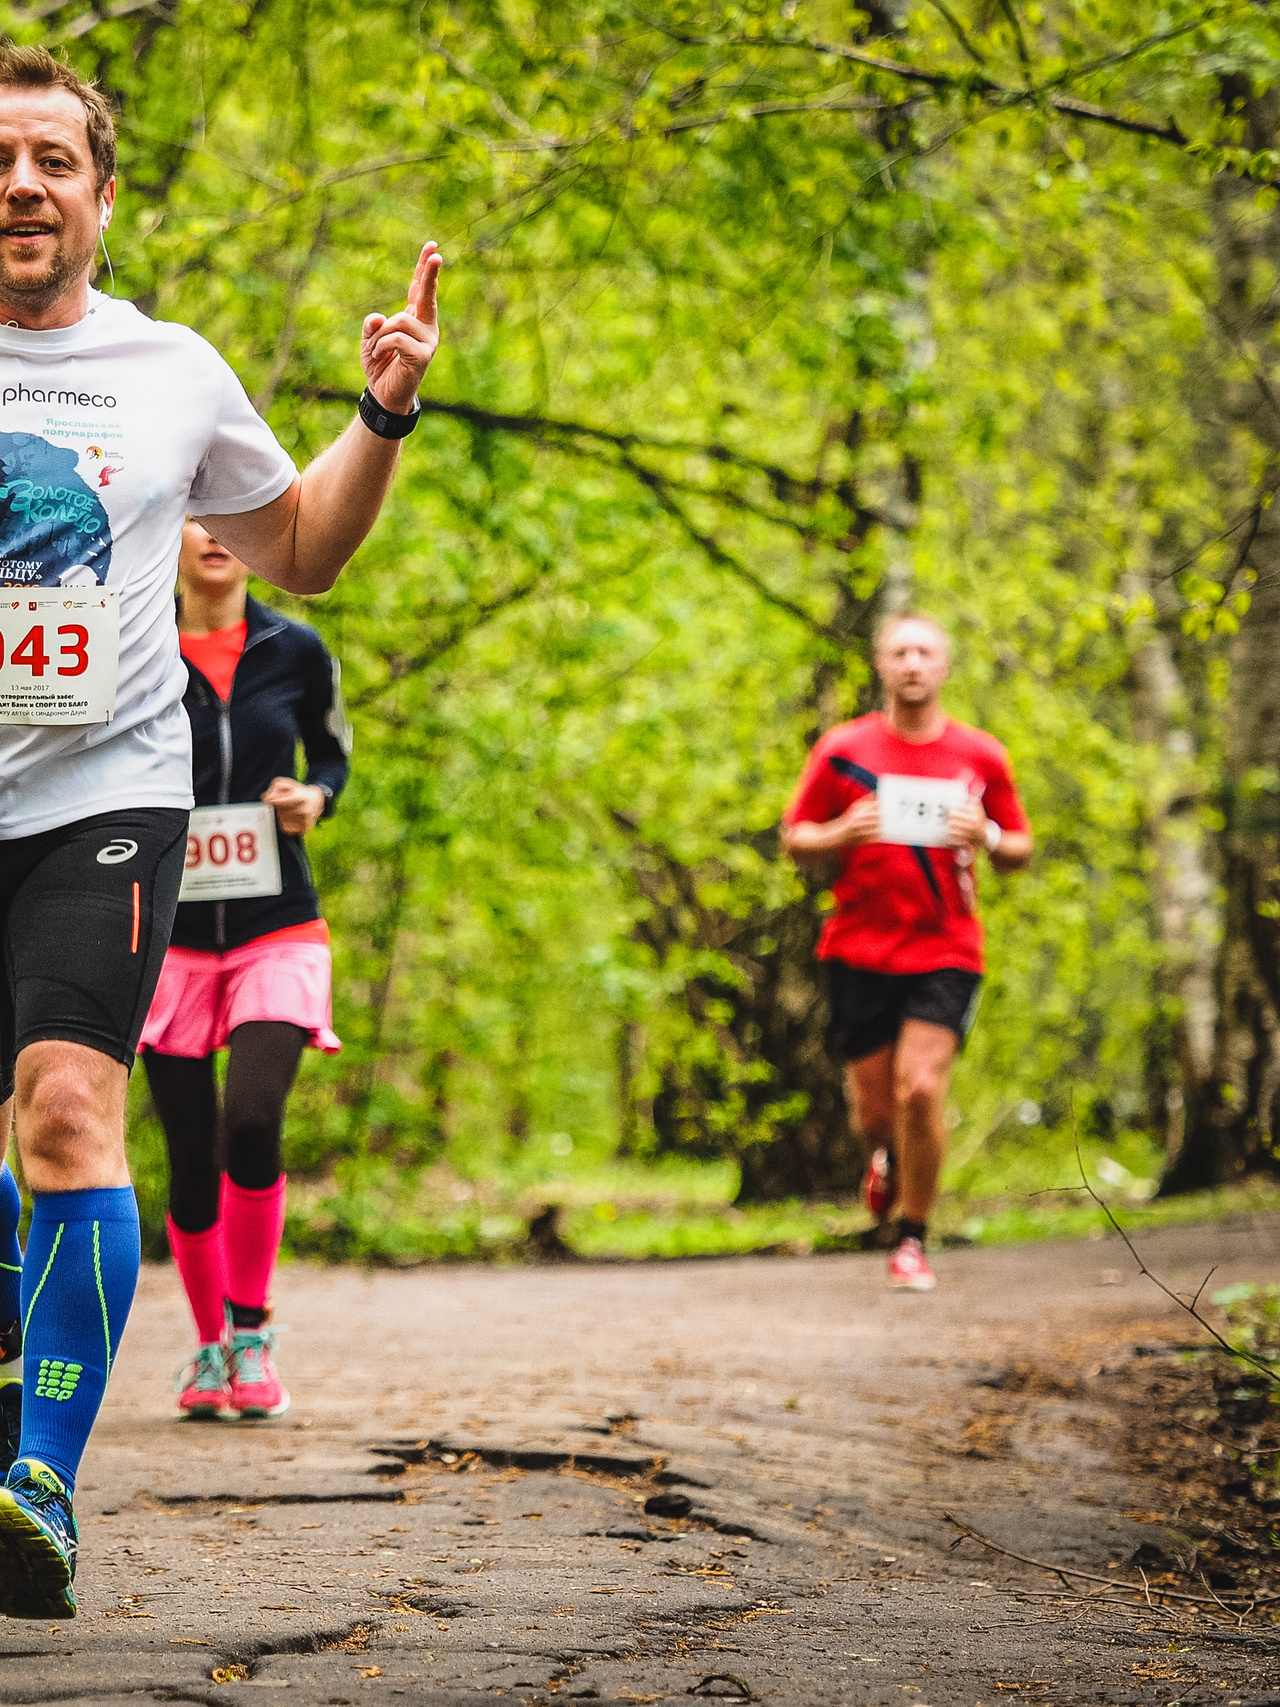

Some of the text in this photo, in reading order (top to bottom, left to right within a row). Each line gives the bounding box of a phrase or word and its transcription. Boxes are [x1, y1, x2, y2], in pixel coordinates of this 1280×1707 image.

[2, 382, 117, 408] pharmeco
[42, 428, 123, 439] полумарафон
[185, 831, 258, 869] 908
[35, 1385, 73, 1401] cep
